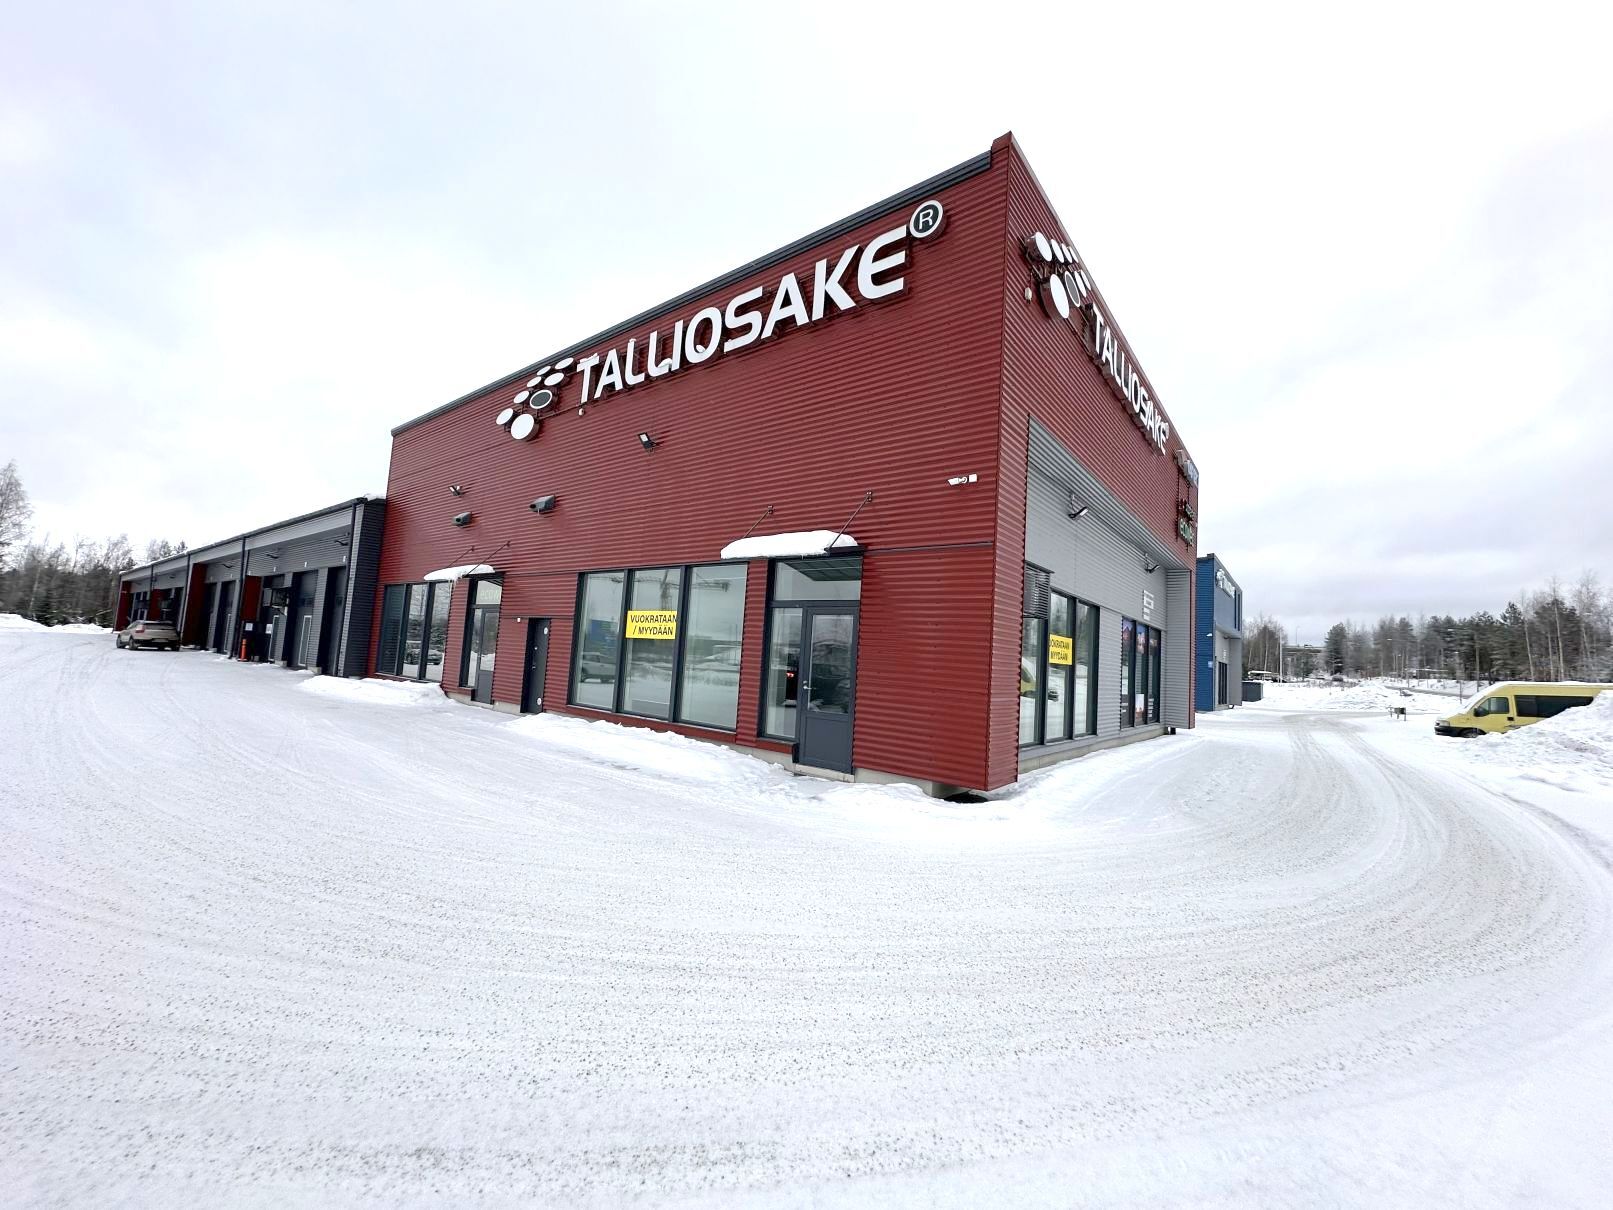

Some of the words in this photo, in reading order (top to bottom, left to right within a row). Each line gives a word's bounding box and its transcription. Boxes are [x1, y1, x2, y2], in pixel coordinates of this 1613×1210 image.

[576, 225, 907, 403] TALLIOSAKE
[1093, 302, 1166, 456] TALLIOSAKE
[630, 614, 677, 623] VUOKRATAAN
[638, 624, 673, 635] MYYDÄÄN
